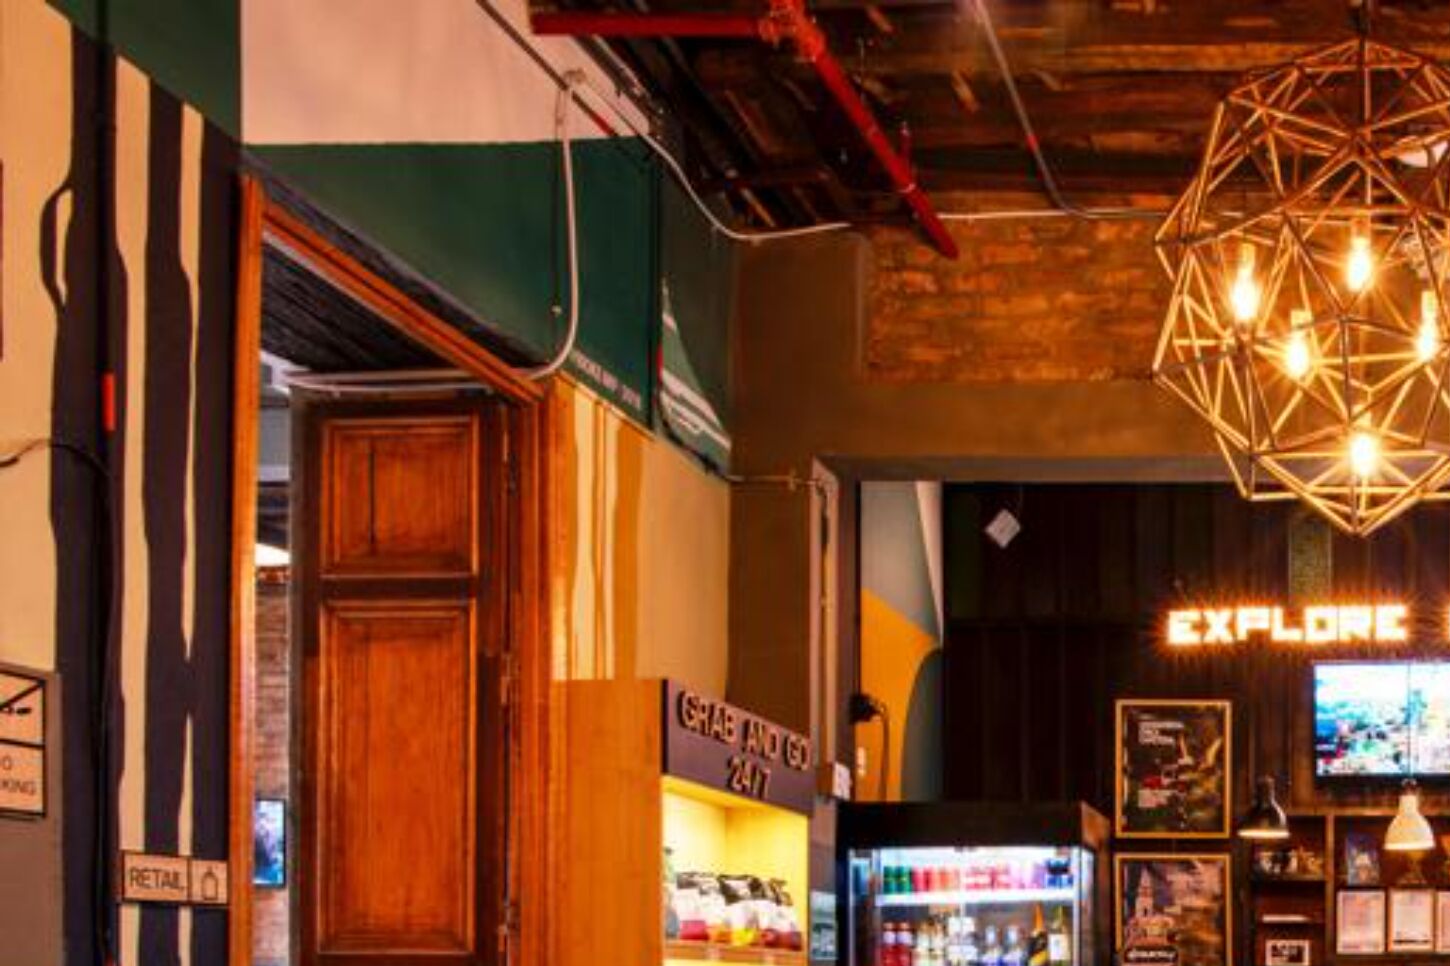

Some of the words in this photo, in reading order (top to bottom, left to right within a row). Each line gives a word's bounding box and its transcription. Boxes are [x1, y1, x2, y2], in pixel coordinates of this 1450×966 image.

[1168, 603, 1406, 645] EXPLORE
[676, 690, 737, 746] GRAB
[741, 718, 780, 761] AND
[783, 733, 813, 772] GO
[129, 867, 187, 892] RETAIL
